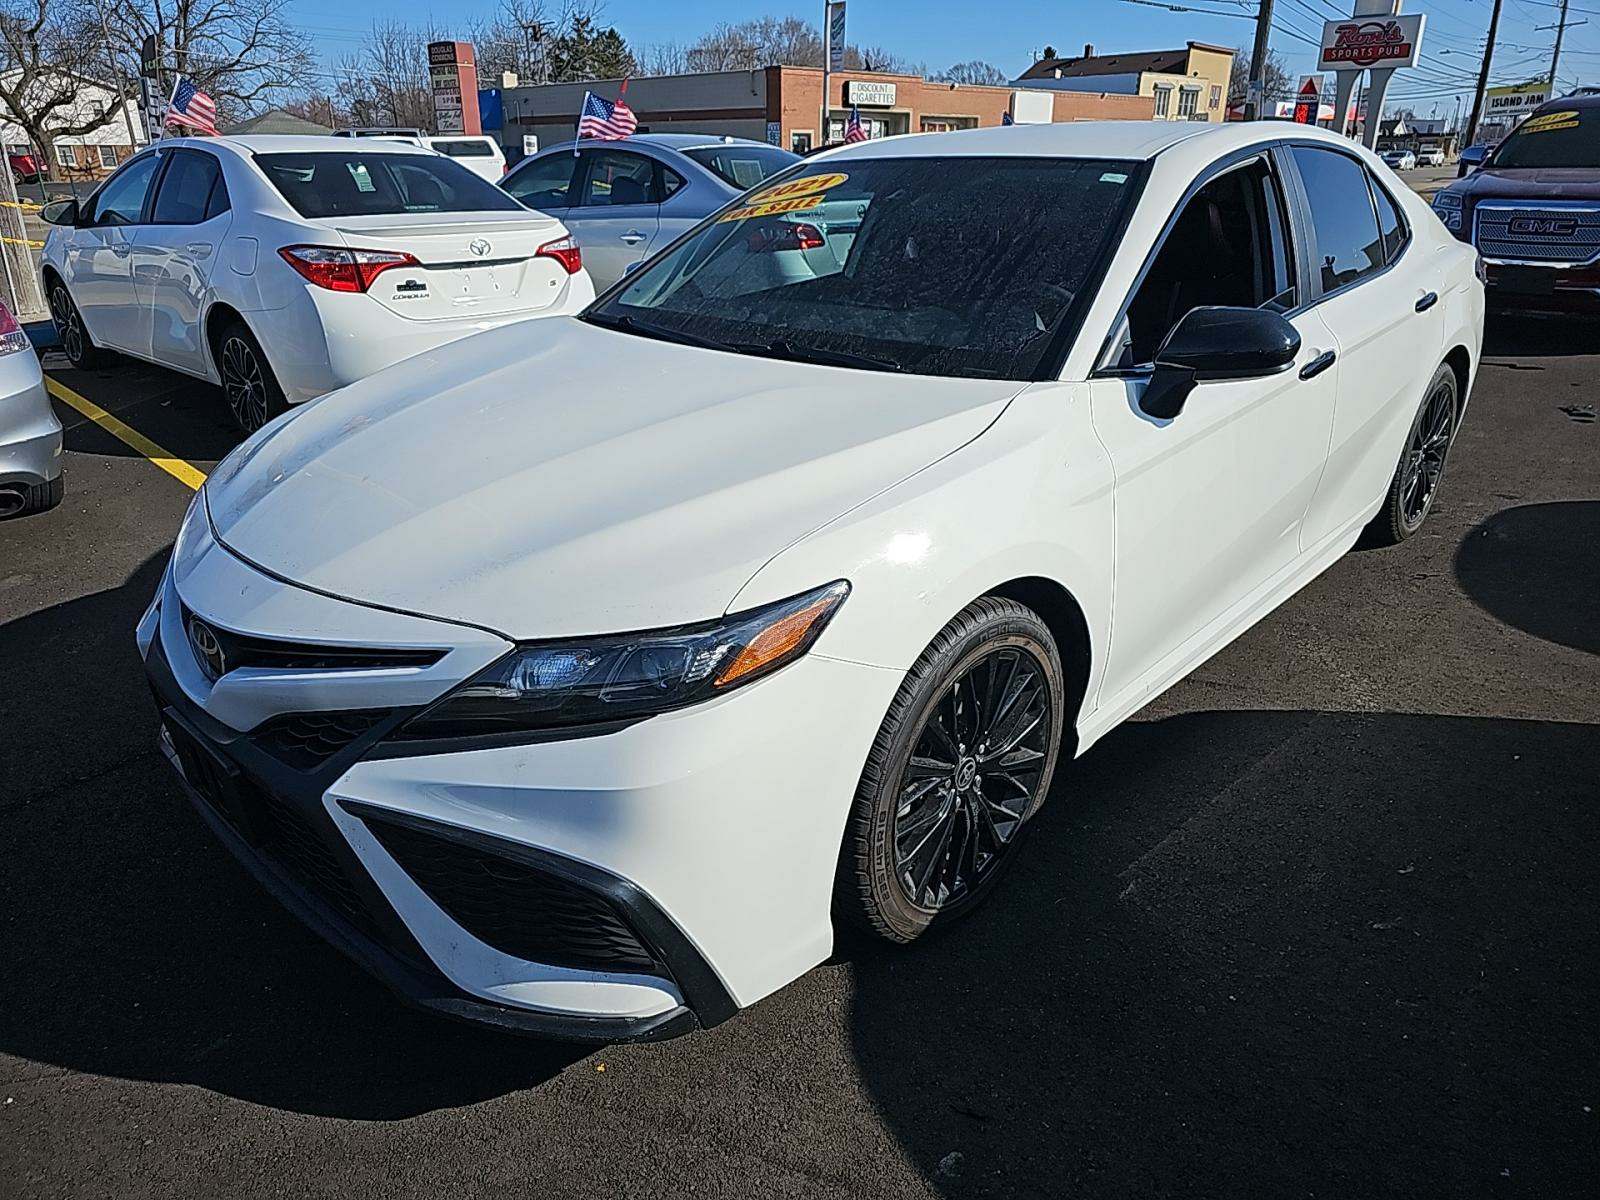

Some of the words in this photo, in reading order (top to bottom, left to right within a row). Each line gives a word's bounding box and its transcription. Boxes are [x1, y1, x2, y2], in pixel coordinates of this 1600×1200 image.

[1335, 21, 1404, 47] Ron's
[1331, 47, 1373, 59] SPORTS
[1378, 46, 1400, 56] PUB
[857, 83, 888, 92] DISCOUNT
[851, 93, 894, 103] CIGARETTES
[1492, 96, 1522, 107] ISLAND
[1525, 94, 1544, 105] JAM
[753, 175, 835, 201] 2021
[722, 207, 759, 221] FOR
[764, 197, 821, 213] SALE
[1511, 219, 1575, 233] GMC
